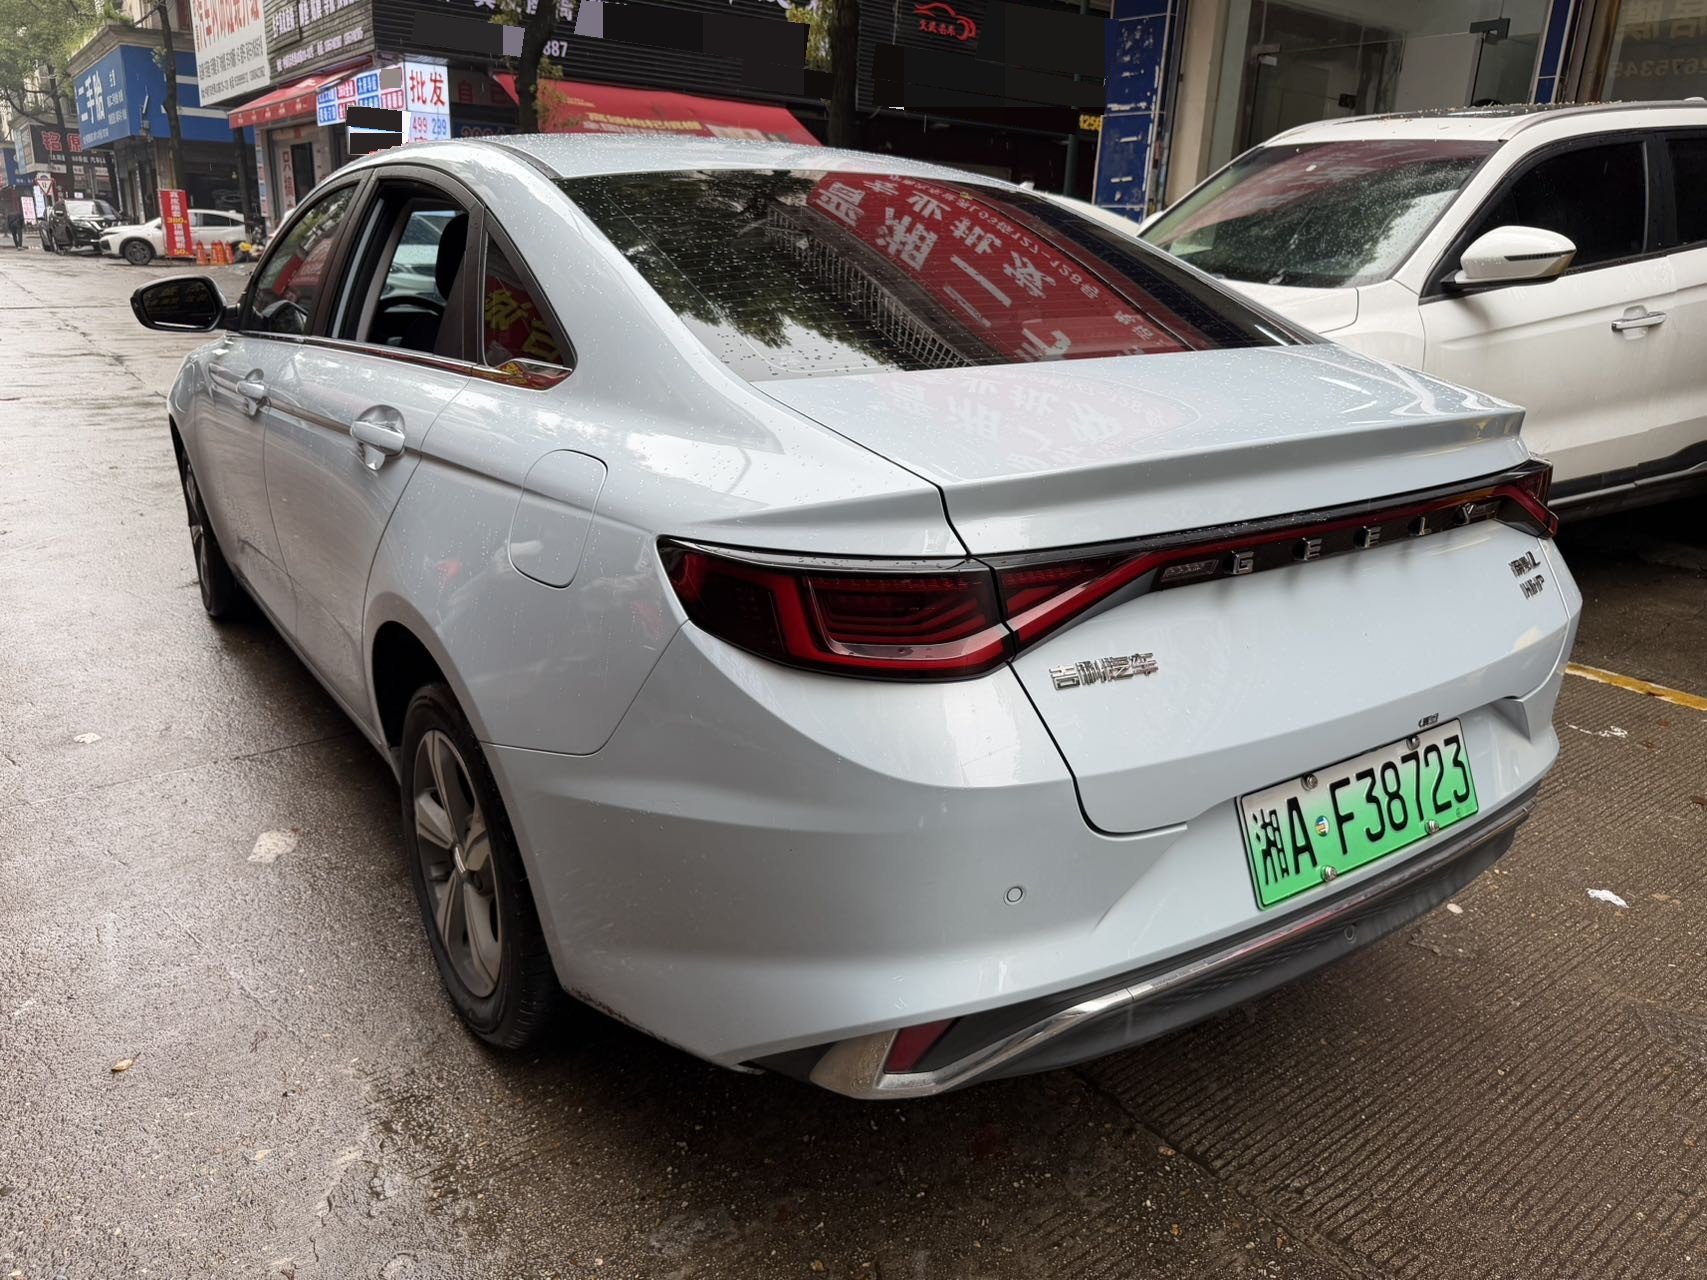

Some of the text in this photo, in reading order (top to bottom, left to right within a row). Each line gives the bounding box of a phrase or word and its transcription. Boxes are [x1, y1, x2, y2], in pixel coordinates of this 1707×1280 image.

[409, 69, 446, 107] 批发
[412, 116, 428, 133] 499
[1229, 501, 1476, 576] GEELY
[1048, 652, 1159, 691] 吉利汽车
